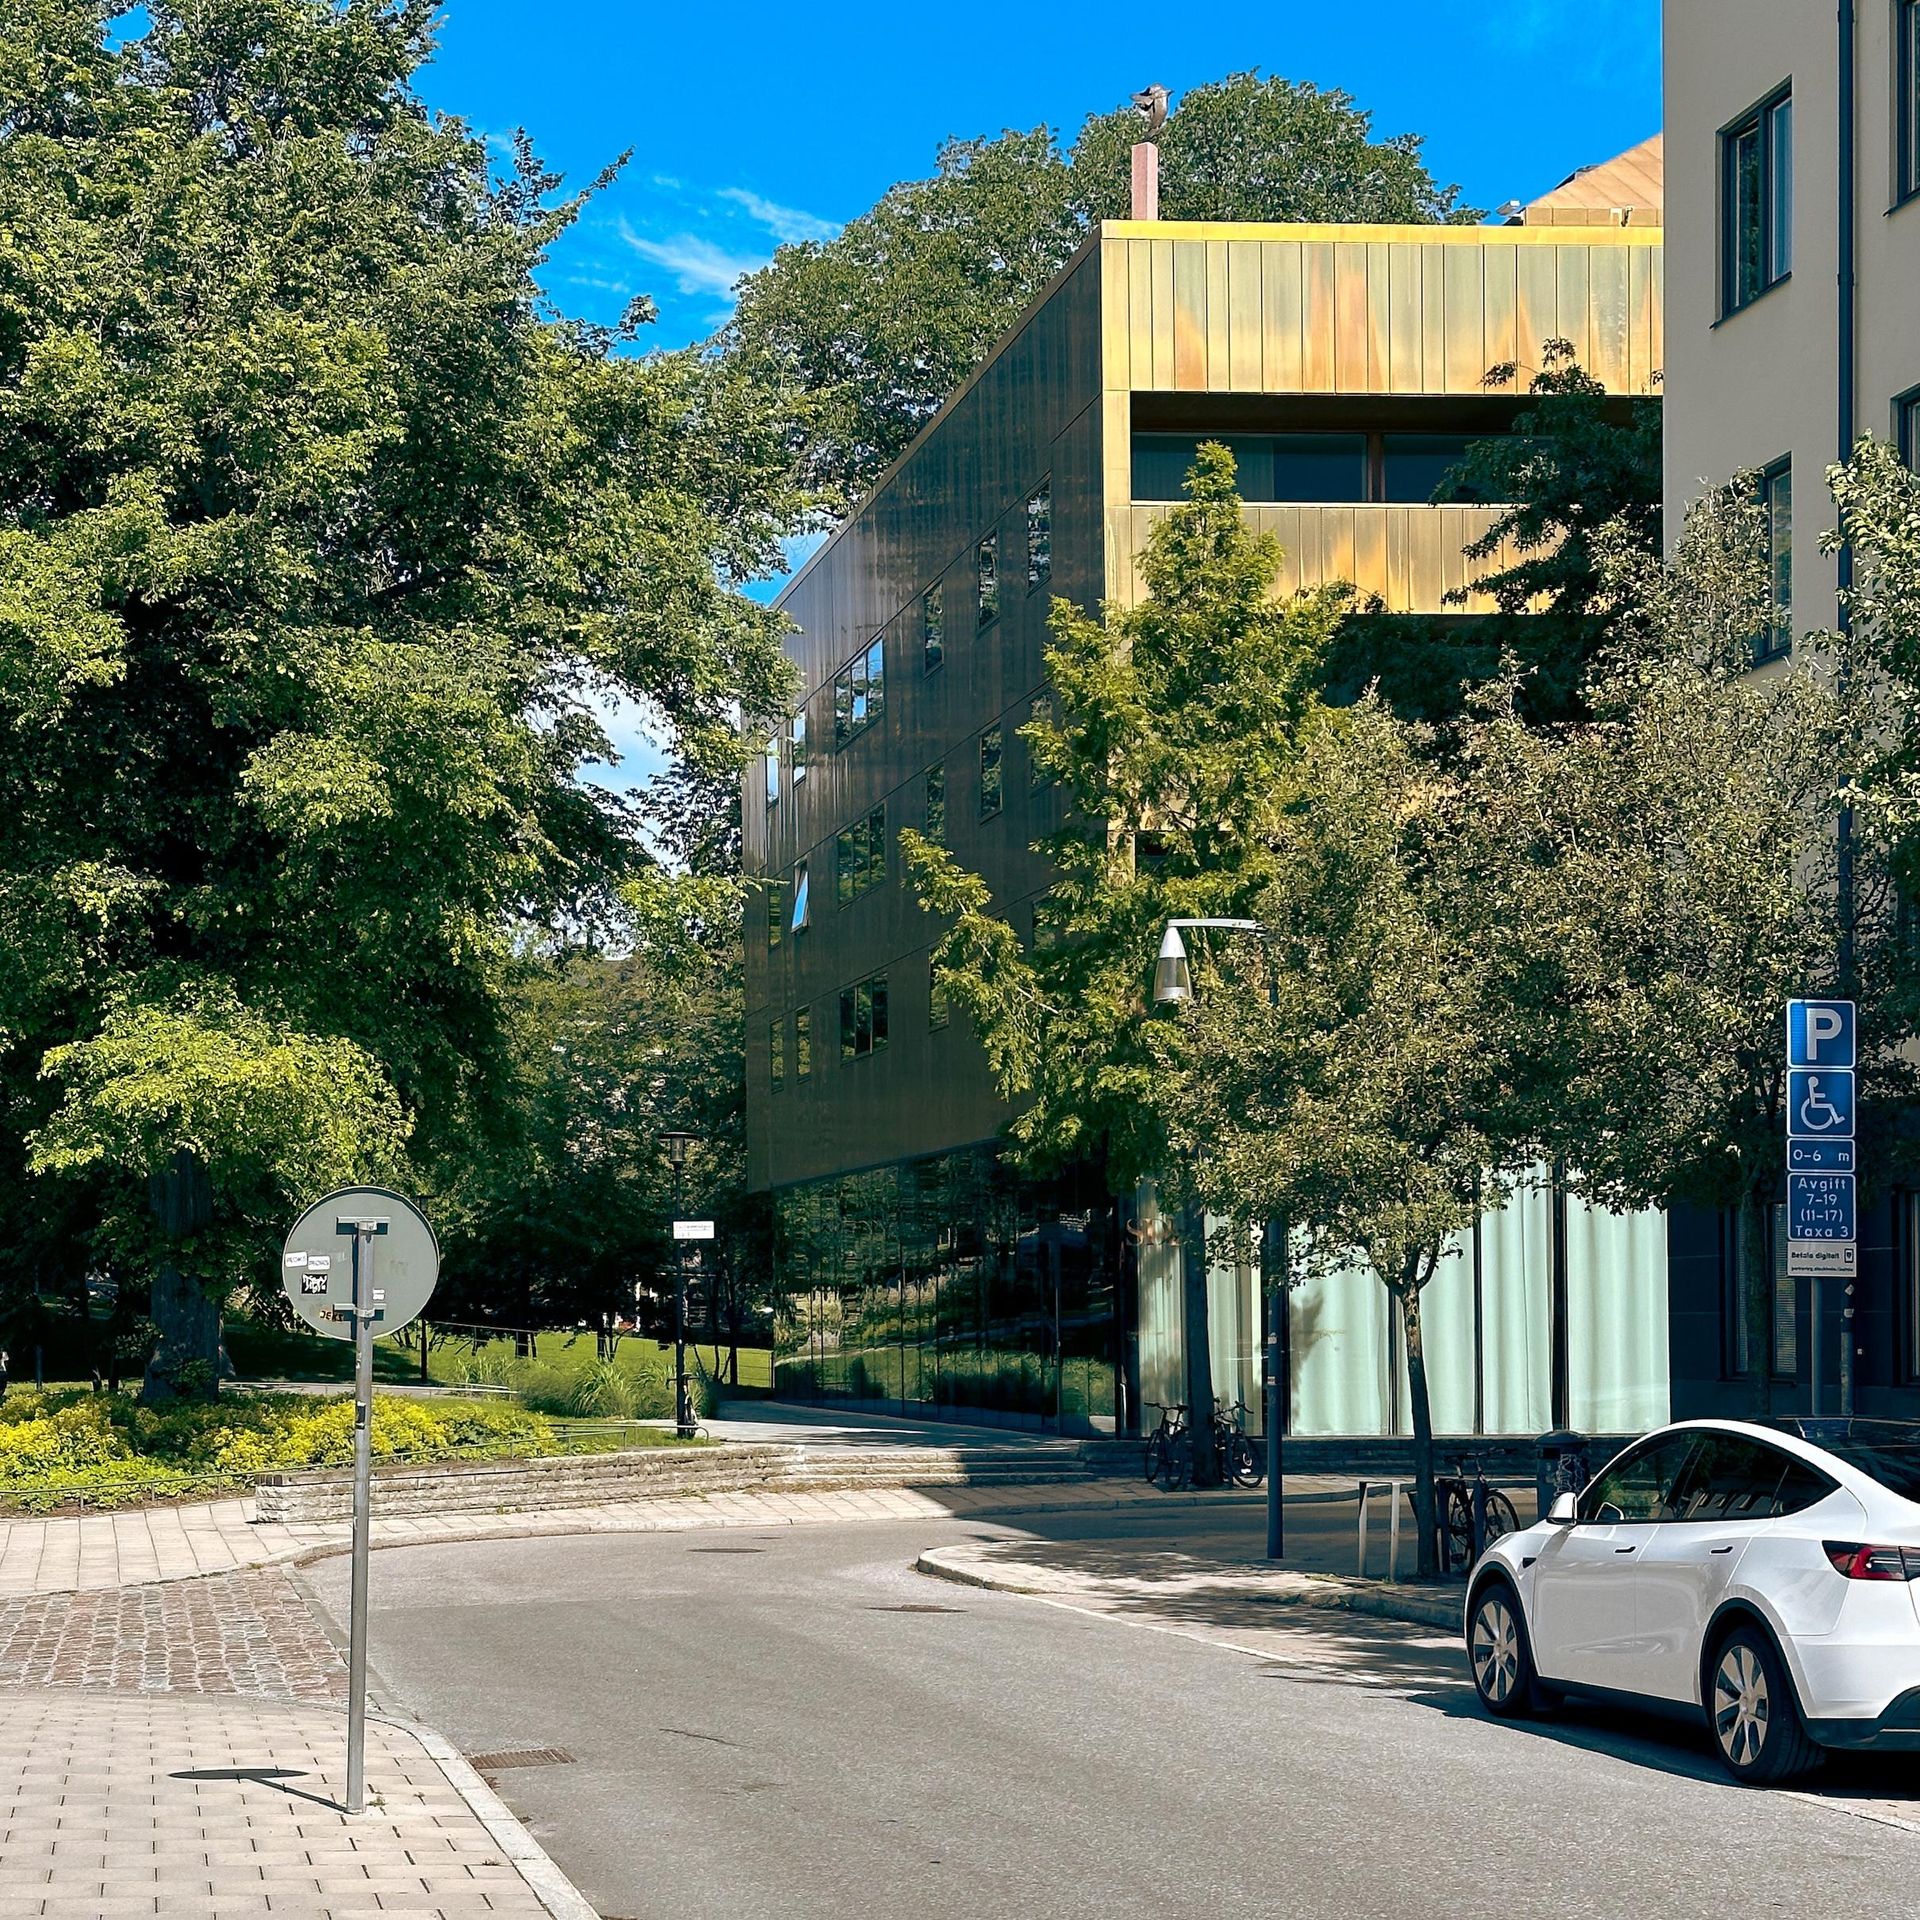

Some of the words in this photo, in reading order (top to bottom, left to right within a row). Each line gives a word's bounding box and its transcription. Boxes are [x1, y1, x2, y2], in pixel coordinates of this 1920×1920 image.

[1806, 1007, 1843, 1060] P
[1793, 1149, 1822, 1161] 0-6
[1838, 1152, 1850, 1162] m
[1798, 1177, 1846, 1192] Avgift
[1805, 1193, 1838, 1206] 7-19
[1800, 1208, 1843, 1223] (11-17)
[1795, 1225, 1833, 1238] Taxa
[1839, 1225, 1849, 1238] 3
